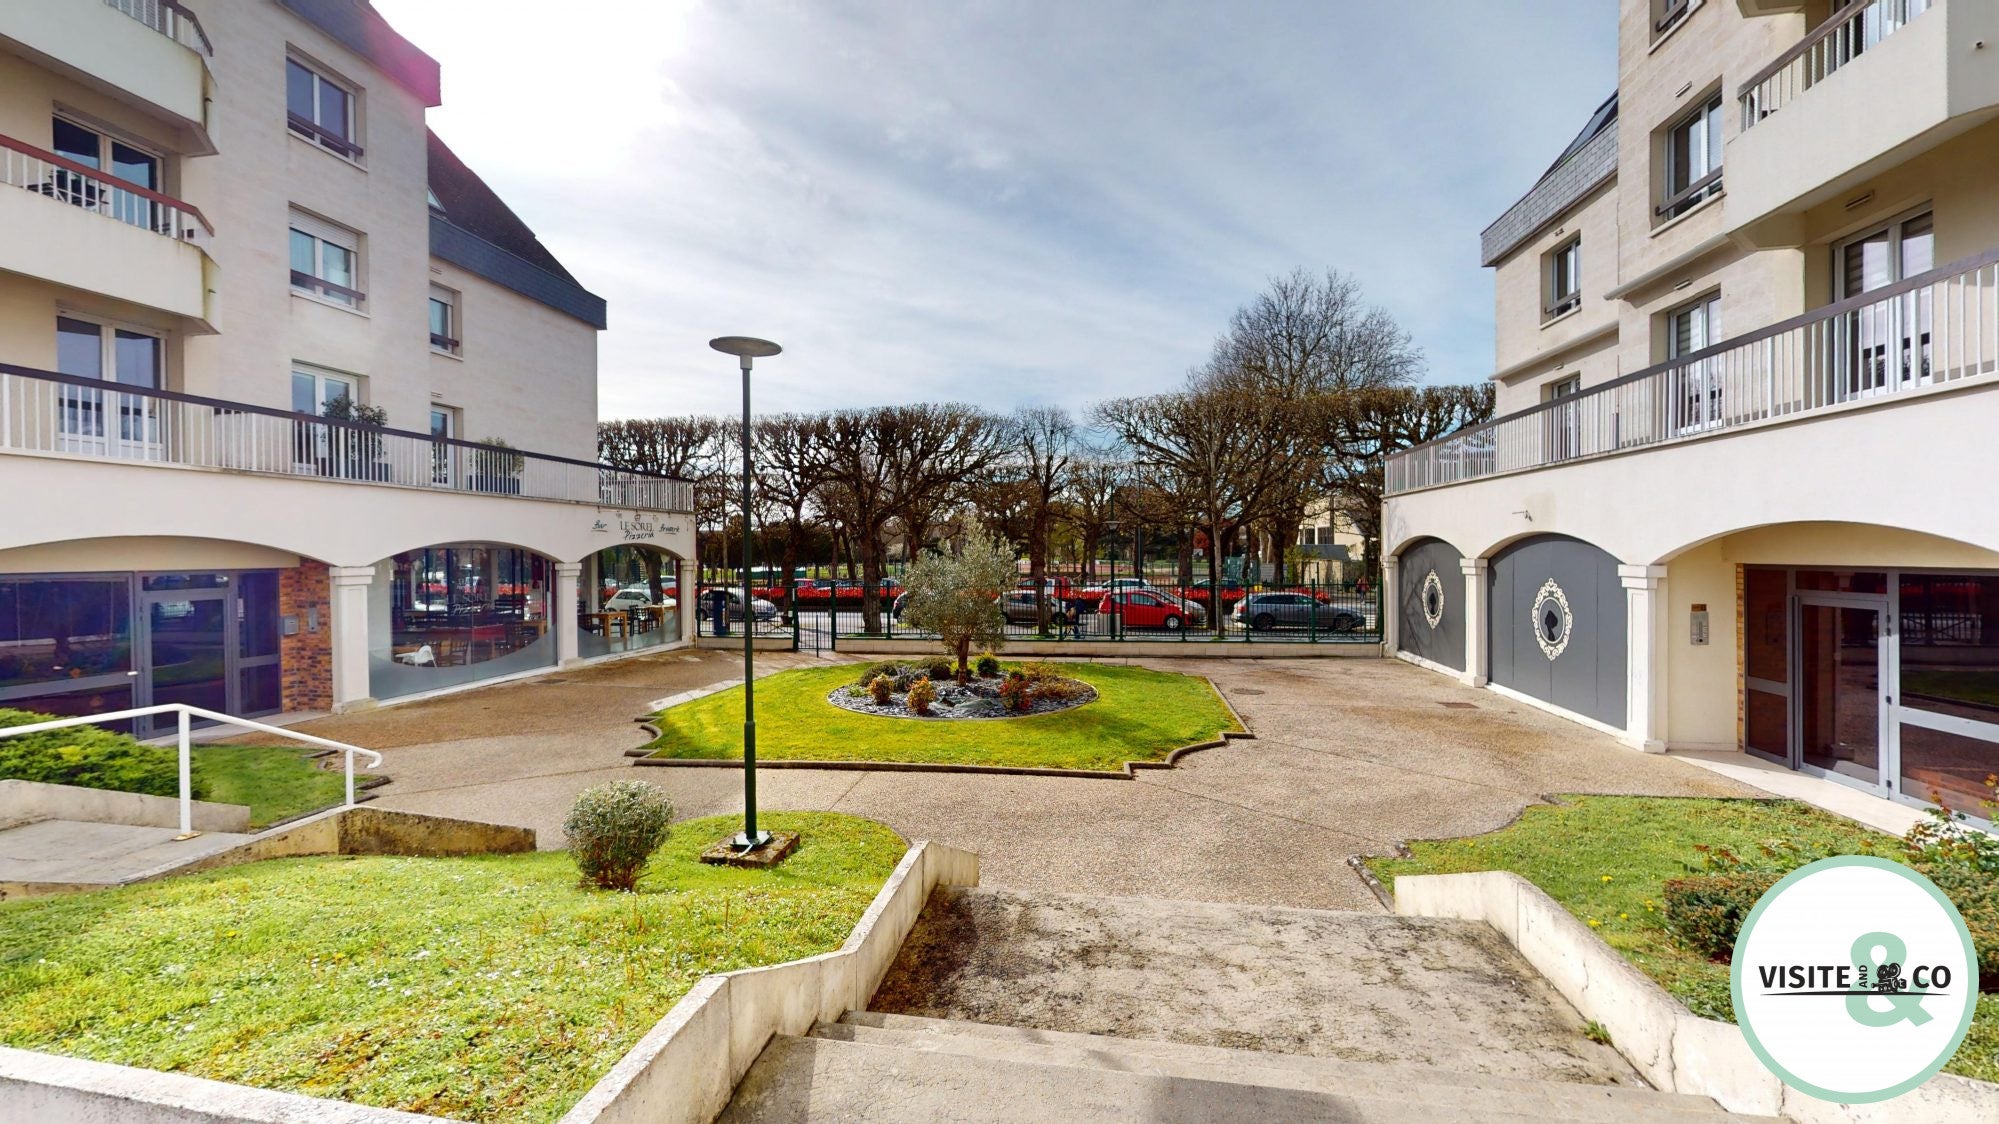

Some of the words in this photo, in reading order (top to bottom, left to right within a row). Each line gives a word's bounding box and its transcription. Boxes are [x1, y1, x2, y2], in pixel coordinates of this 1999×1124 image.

[620, 520, 630, 530] LE
[631, 521, 653, 532] SOREL
[624, 528, 654, 541] Pizzeria
